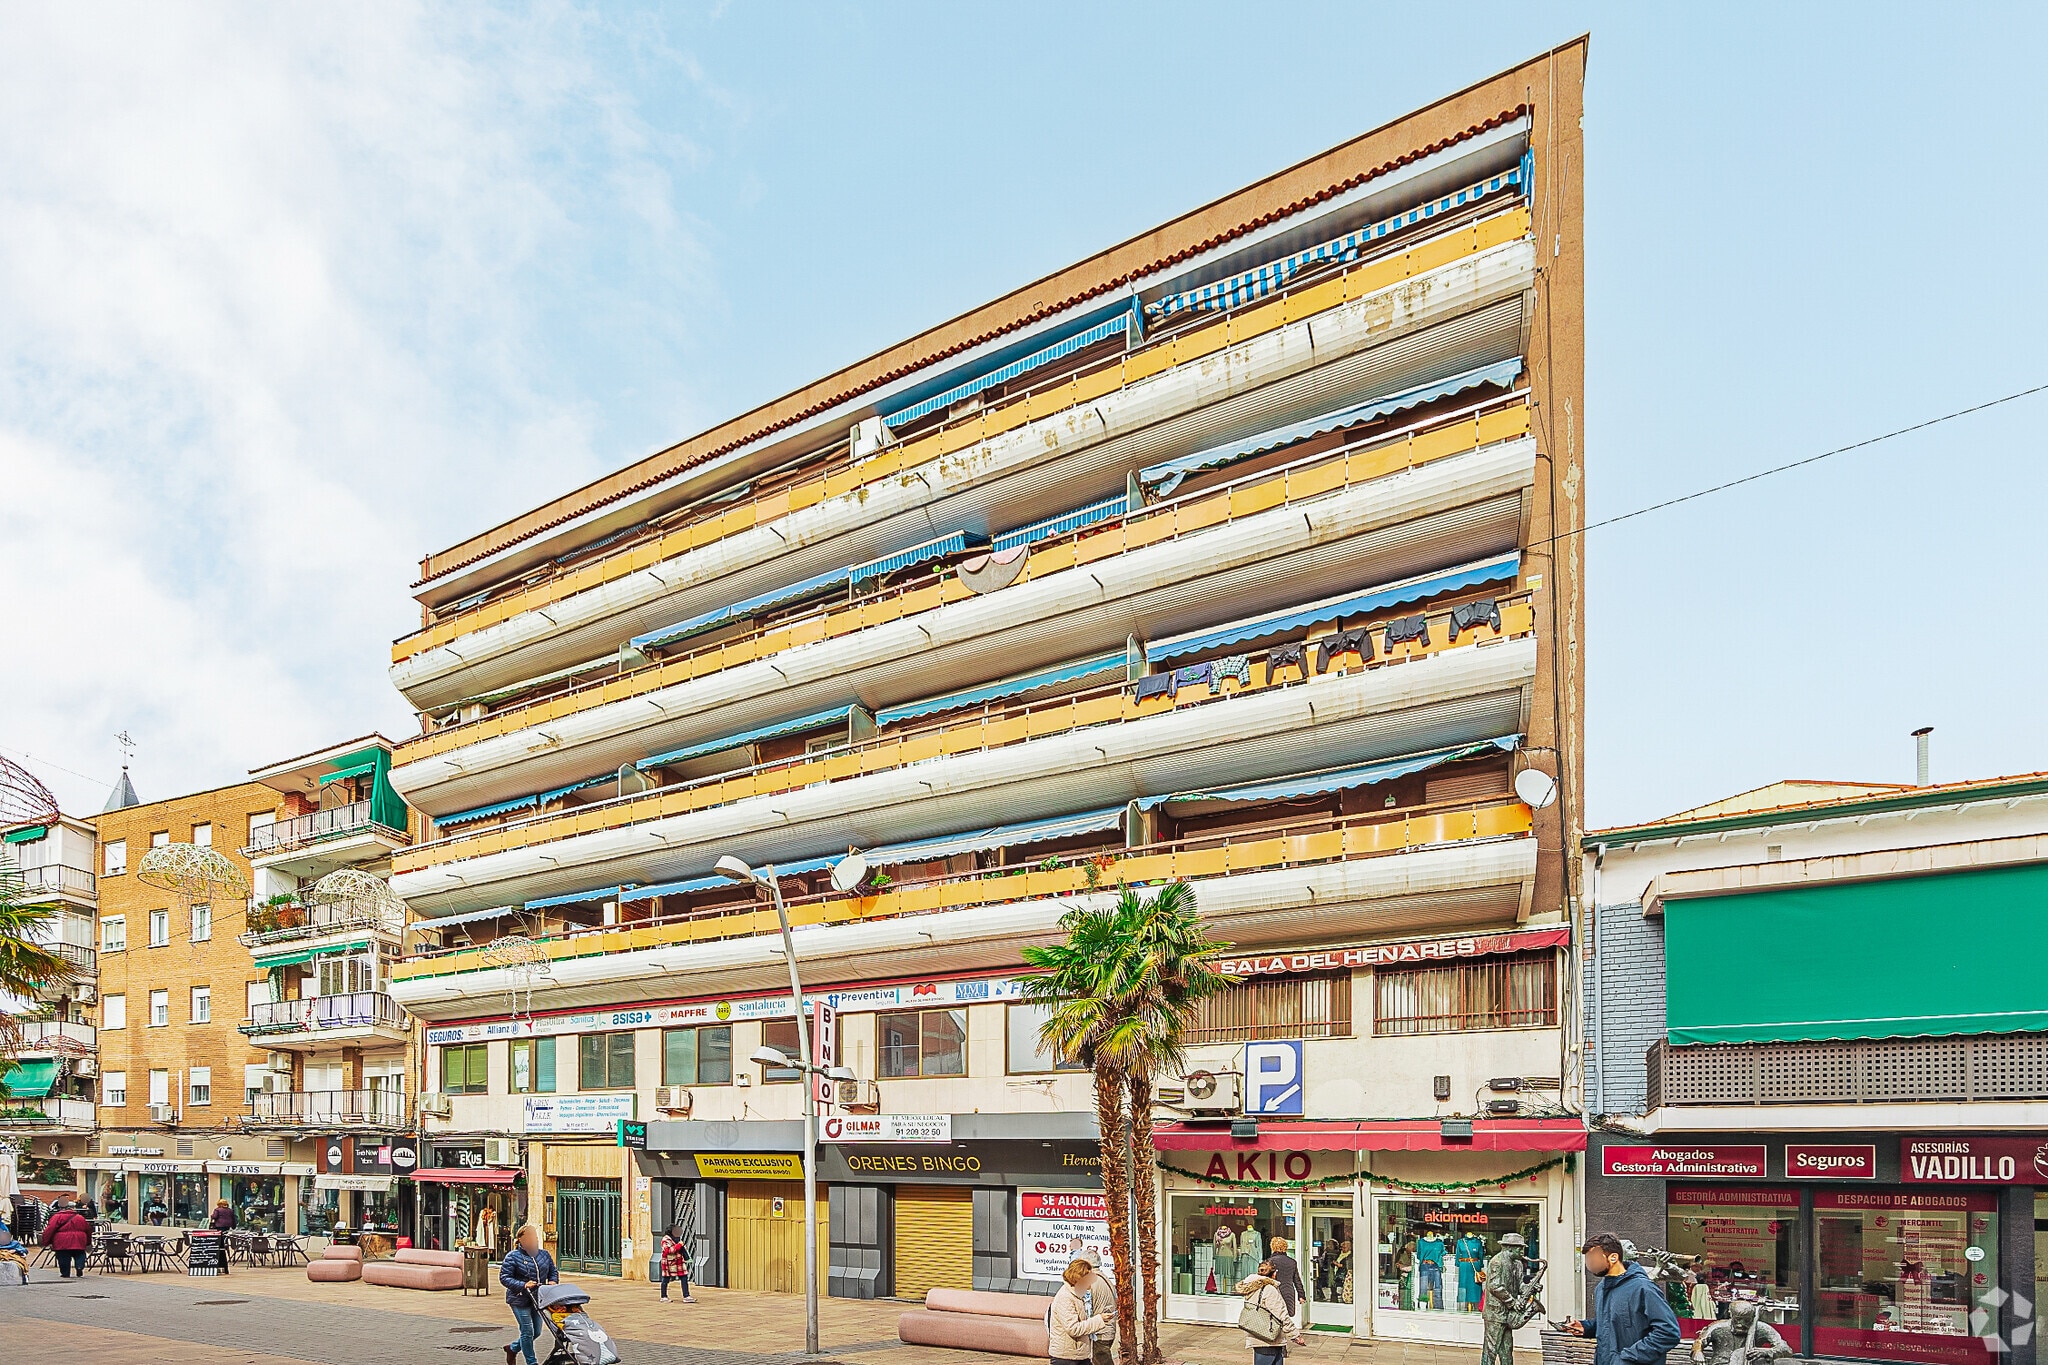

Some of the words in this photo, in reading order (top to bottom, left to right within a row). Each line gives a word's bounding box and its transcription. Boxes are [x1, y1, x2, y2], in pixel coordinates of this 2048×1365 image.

[1221, 957, 1286, 974] SALA
[1291, 953, 1338, 970] DEL
[1344, 938, 1476, 966] HENARES
[841, 989, 895, 1003] Preventiva
[738, 997, 786, 1012] santalucía
[670, 1007, 708, 1019] MAPFRE
[428, 1029, 464, 1043] SEGUROS:
[487, 1025, 510, 1035] Allianz
[1246, 1044, 1297, 1112] P
[846, 1121, 880, 1131] GILMAR
[1910, 1142, 1969, 1154] ASESORÍAS
[703, 1158, 740, 1167] PARKING
[743, 1158, 792, 1167] EXCLUSIVO
[1651, 1149, 1715, 1163] Abogados
[1797, 1153, 1866, 1170] Seguros
[144, 1163, 179, 1171] KOYOTE
[848, 1155, 917, 1172] ORENES
[923, 1156, 981, 1173] BINGO
[1205, 1152, 1312, 1181] AKIO
[1612, 1162, 1664, 1176] Gestoría
[1666, 1162, 1758, 1174] Administrativa
[1910, 1155, 2015, 1180] VADILLO
[1042, 1195, 1055, 1206] SE
[1057, 1195, 1107, 1208] ALQUILA
[1676, 1191, 1717, 1201] GESTORÍA
[1719, 1193, 1792, 1203] ADMINISTRATIVA
[1838, 1194, 1891, 1205] DESPACHO
[1894, 1195, 1908, 1205] DE
[1910, 1196, 1967, 1207] ABOGADOS
[1034, 1207, 1061, 1216] LOCAL
[1063, 1208, 1109, 1218] COMERCIA
[1205, 1205, 1258, 1216] akiomoda
[1424, 1211, 1489, 1224] akiomoda
[1900, 1219, 1943, 1227] MERCANTIL
[1704, 1227, 1759, 1235] ADMINISTRATIVA
[1049, 1243, 1067, 1253] 629
